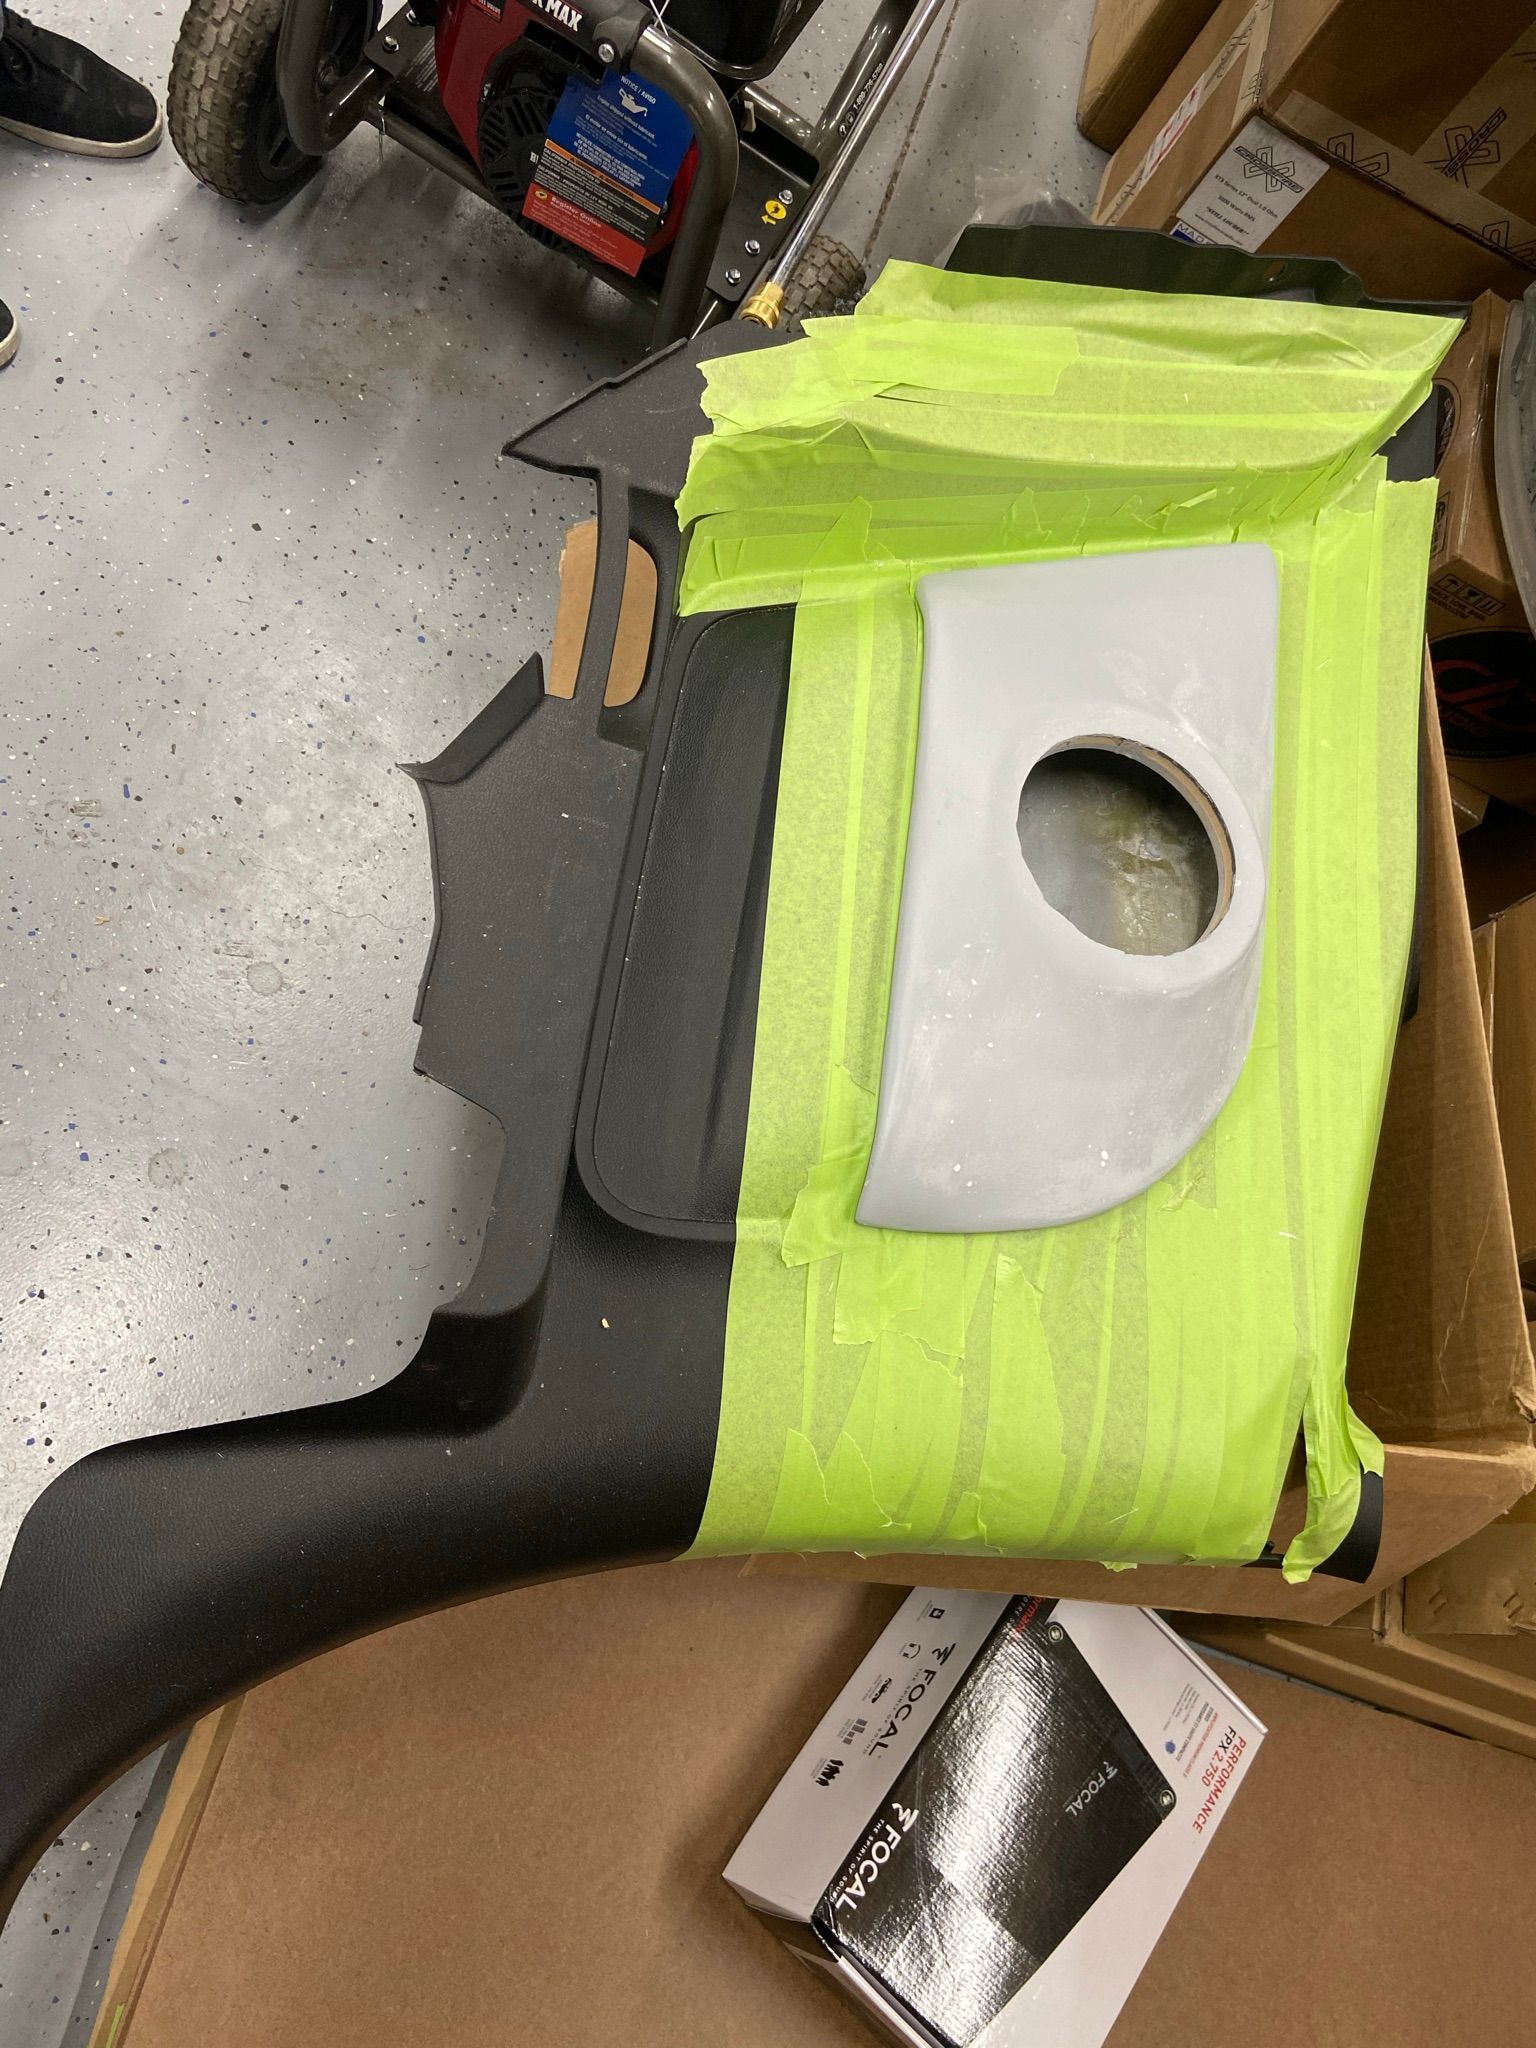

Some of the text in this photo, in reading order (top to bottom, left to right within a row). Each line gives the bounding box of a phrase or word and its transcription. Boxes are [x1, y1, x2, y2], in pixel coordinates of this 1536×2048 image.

[544, 0, 583, 32] MAX
[619, 75, 639, 92] NOTICE
[640, 90, 657, 104] AVISO
[1237, 146, 1300, 193] CROSSFIRE
[550, 196, 602, 228] Register Online
[911, 1667, 922, 1681] THE
[868, 1669, 936, 1758] FOCAL
[891, 1685, 910, 1710] SPIRIT
[861, 1727, 882, 1755] SOUND
[1200, 1725, 1236, 1787] FPX 2.750
[1064, 1771, 1106, 1816] FOCAL
[1191, 1735, 1246, 1833] PERFORMANCE
[828, 1818, 884, 1903] THE SPIRIT OF SOUND
[834, 1823, 901, 1910] FOCAL
